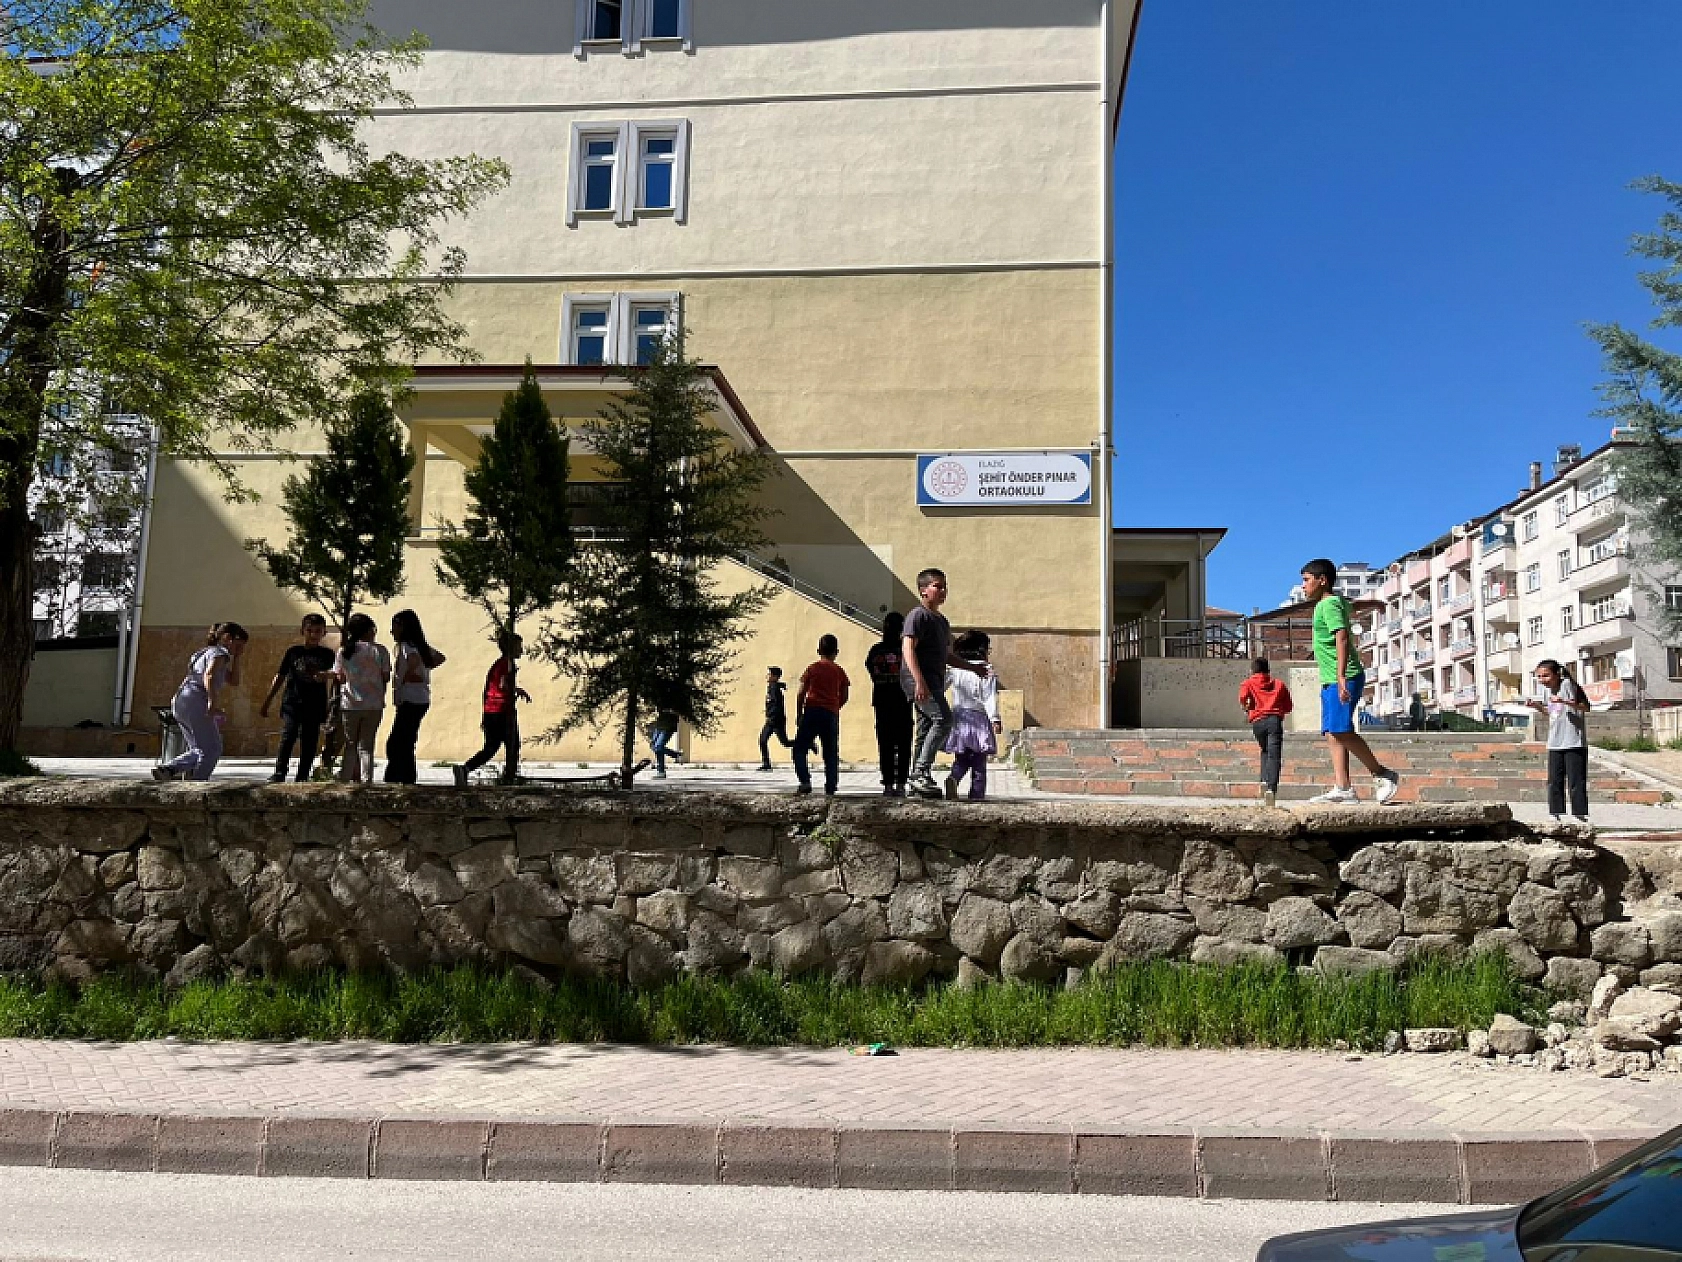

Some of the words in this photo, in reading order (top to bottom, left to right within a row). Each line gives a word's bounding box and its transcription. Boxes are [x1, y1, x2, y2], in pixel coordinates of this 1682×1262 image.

[979, 471, 1007, 486] ŞEHİT
[1008, 471, 1044, 483] ÖNDER
[1045, 472, 1077, 483] PINAR
[979, 486, 1045, 497] ORTAOKULU
